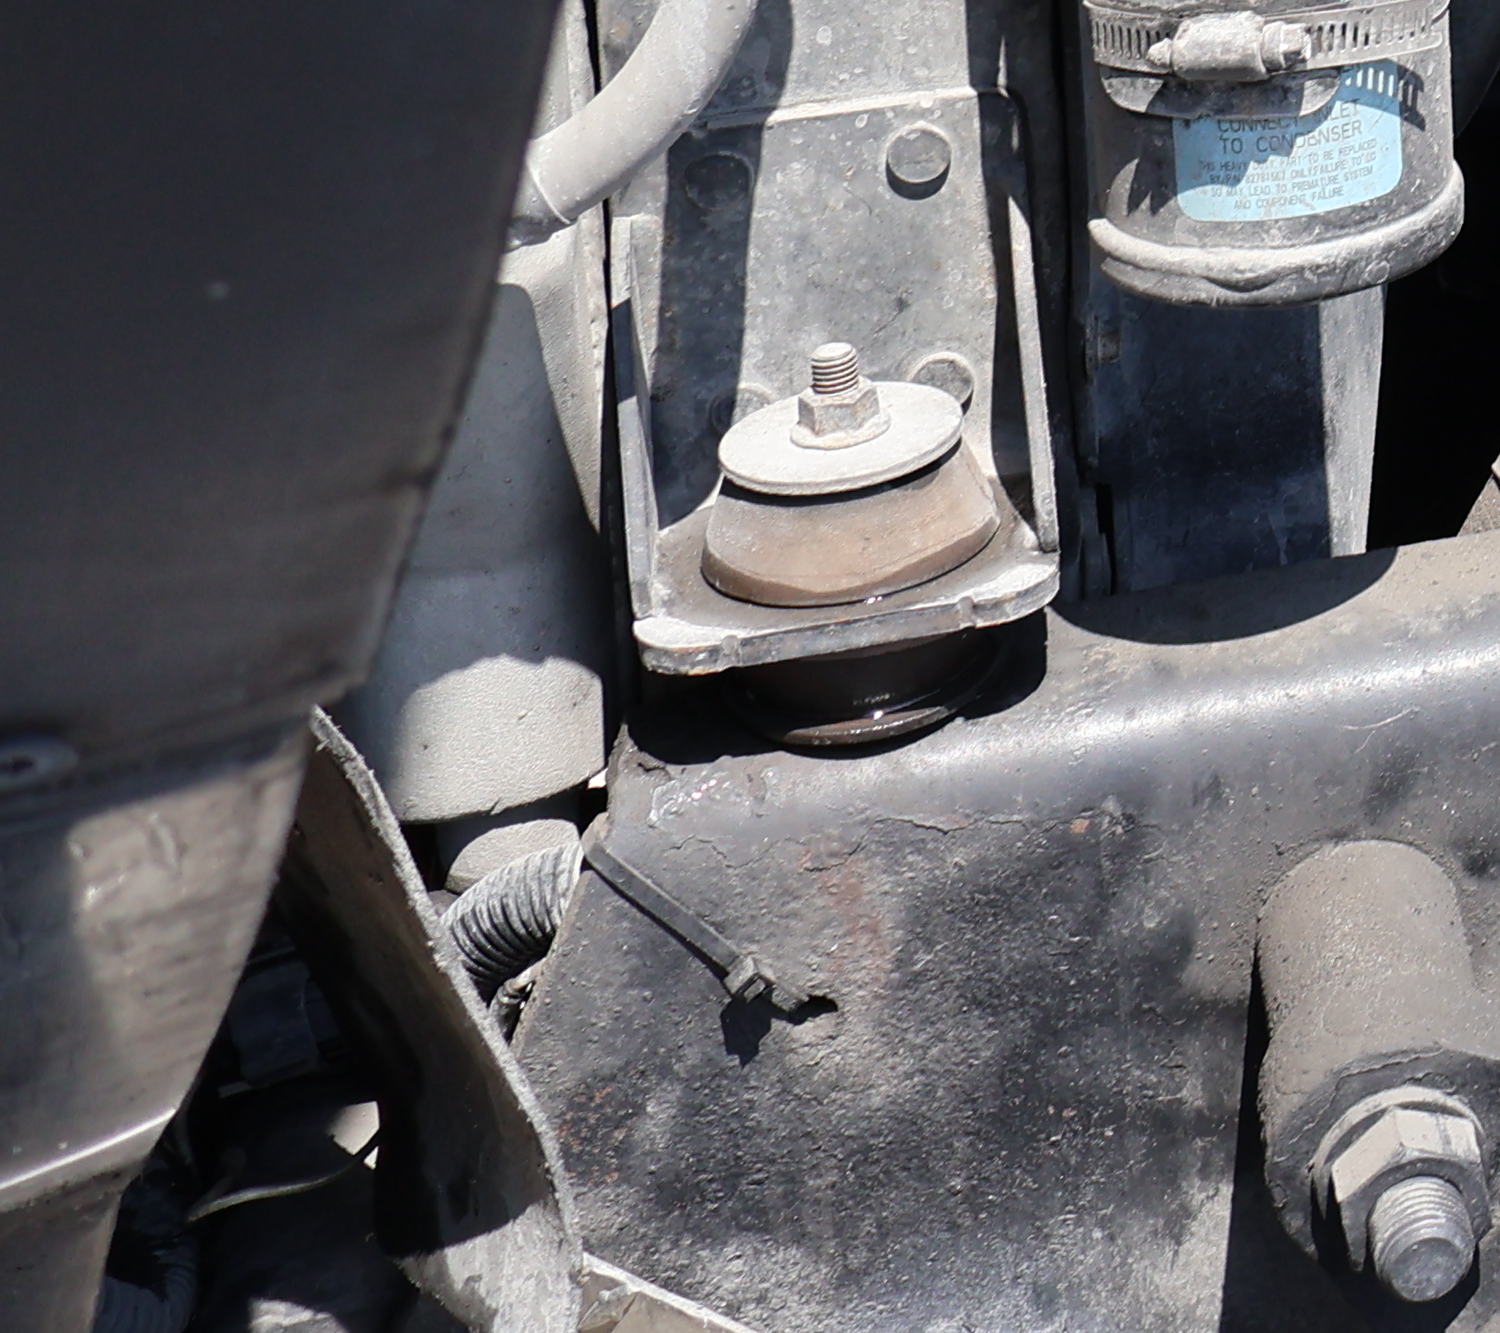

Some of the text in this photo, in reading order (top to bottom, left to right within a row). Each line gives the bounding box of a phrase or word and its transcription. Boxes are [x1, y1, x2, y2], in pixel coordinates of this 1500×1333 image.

[1220, 135, 1243, 154] TO
[1323, 149, 1334, 161] BE
[1338, 138, 1377, 157] REPLACED
[1250, 183, 1271, 197] LEAD
[1275, 182, 1287, 194] TO
[1291, 173, 1341, 193] PREMATURE
[1344, 164, 1374, 183] SYSTEM
[1233, 198, 1252, 211] AND
[1310, 185, 1345, 202] FAILURE
